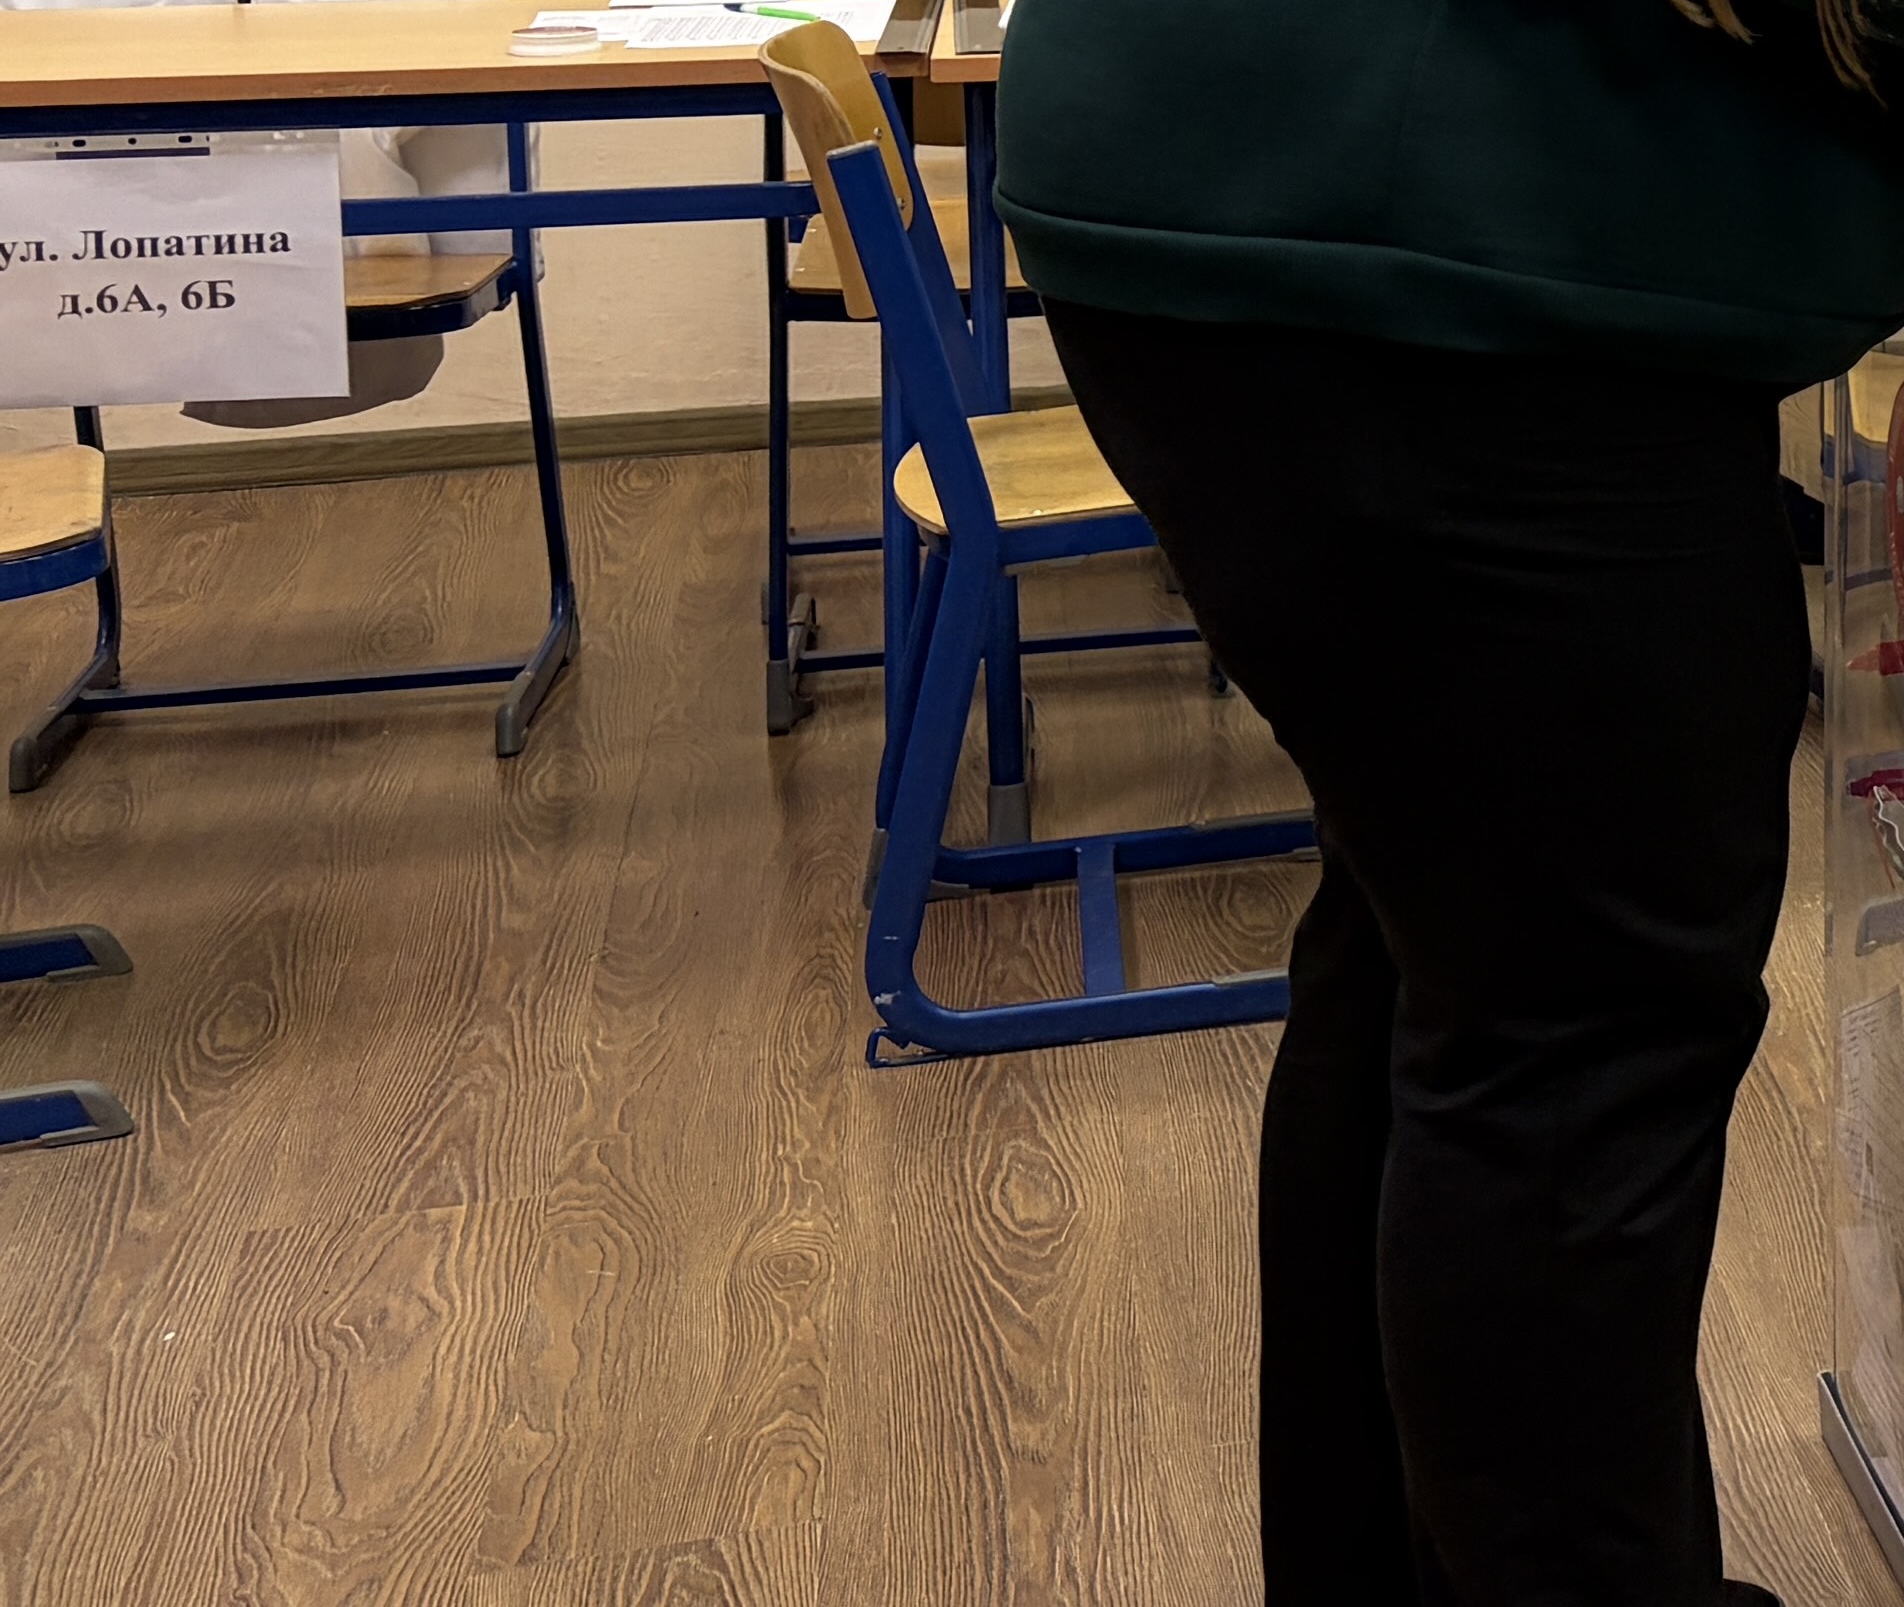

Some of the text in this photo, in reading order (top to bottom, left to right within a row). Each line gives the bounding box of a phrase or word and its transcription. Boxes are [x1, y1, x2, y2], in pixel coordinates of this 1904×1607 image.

[0, 228, 291, 271] ул. Лопатина
[58, 278, 237, 320] д.6А, 6Б
